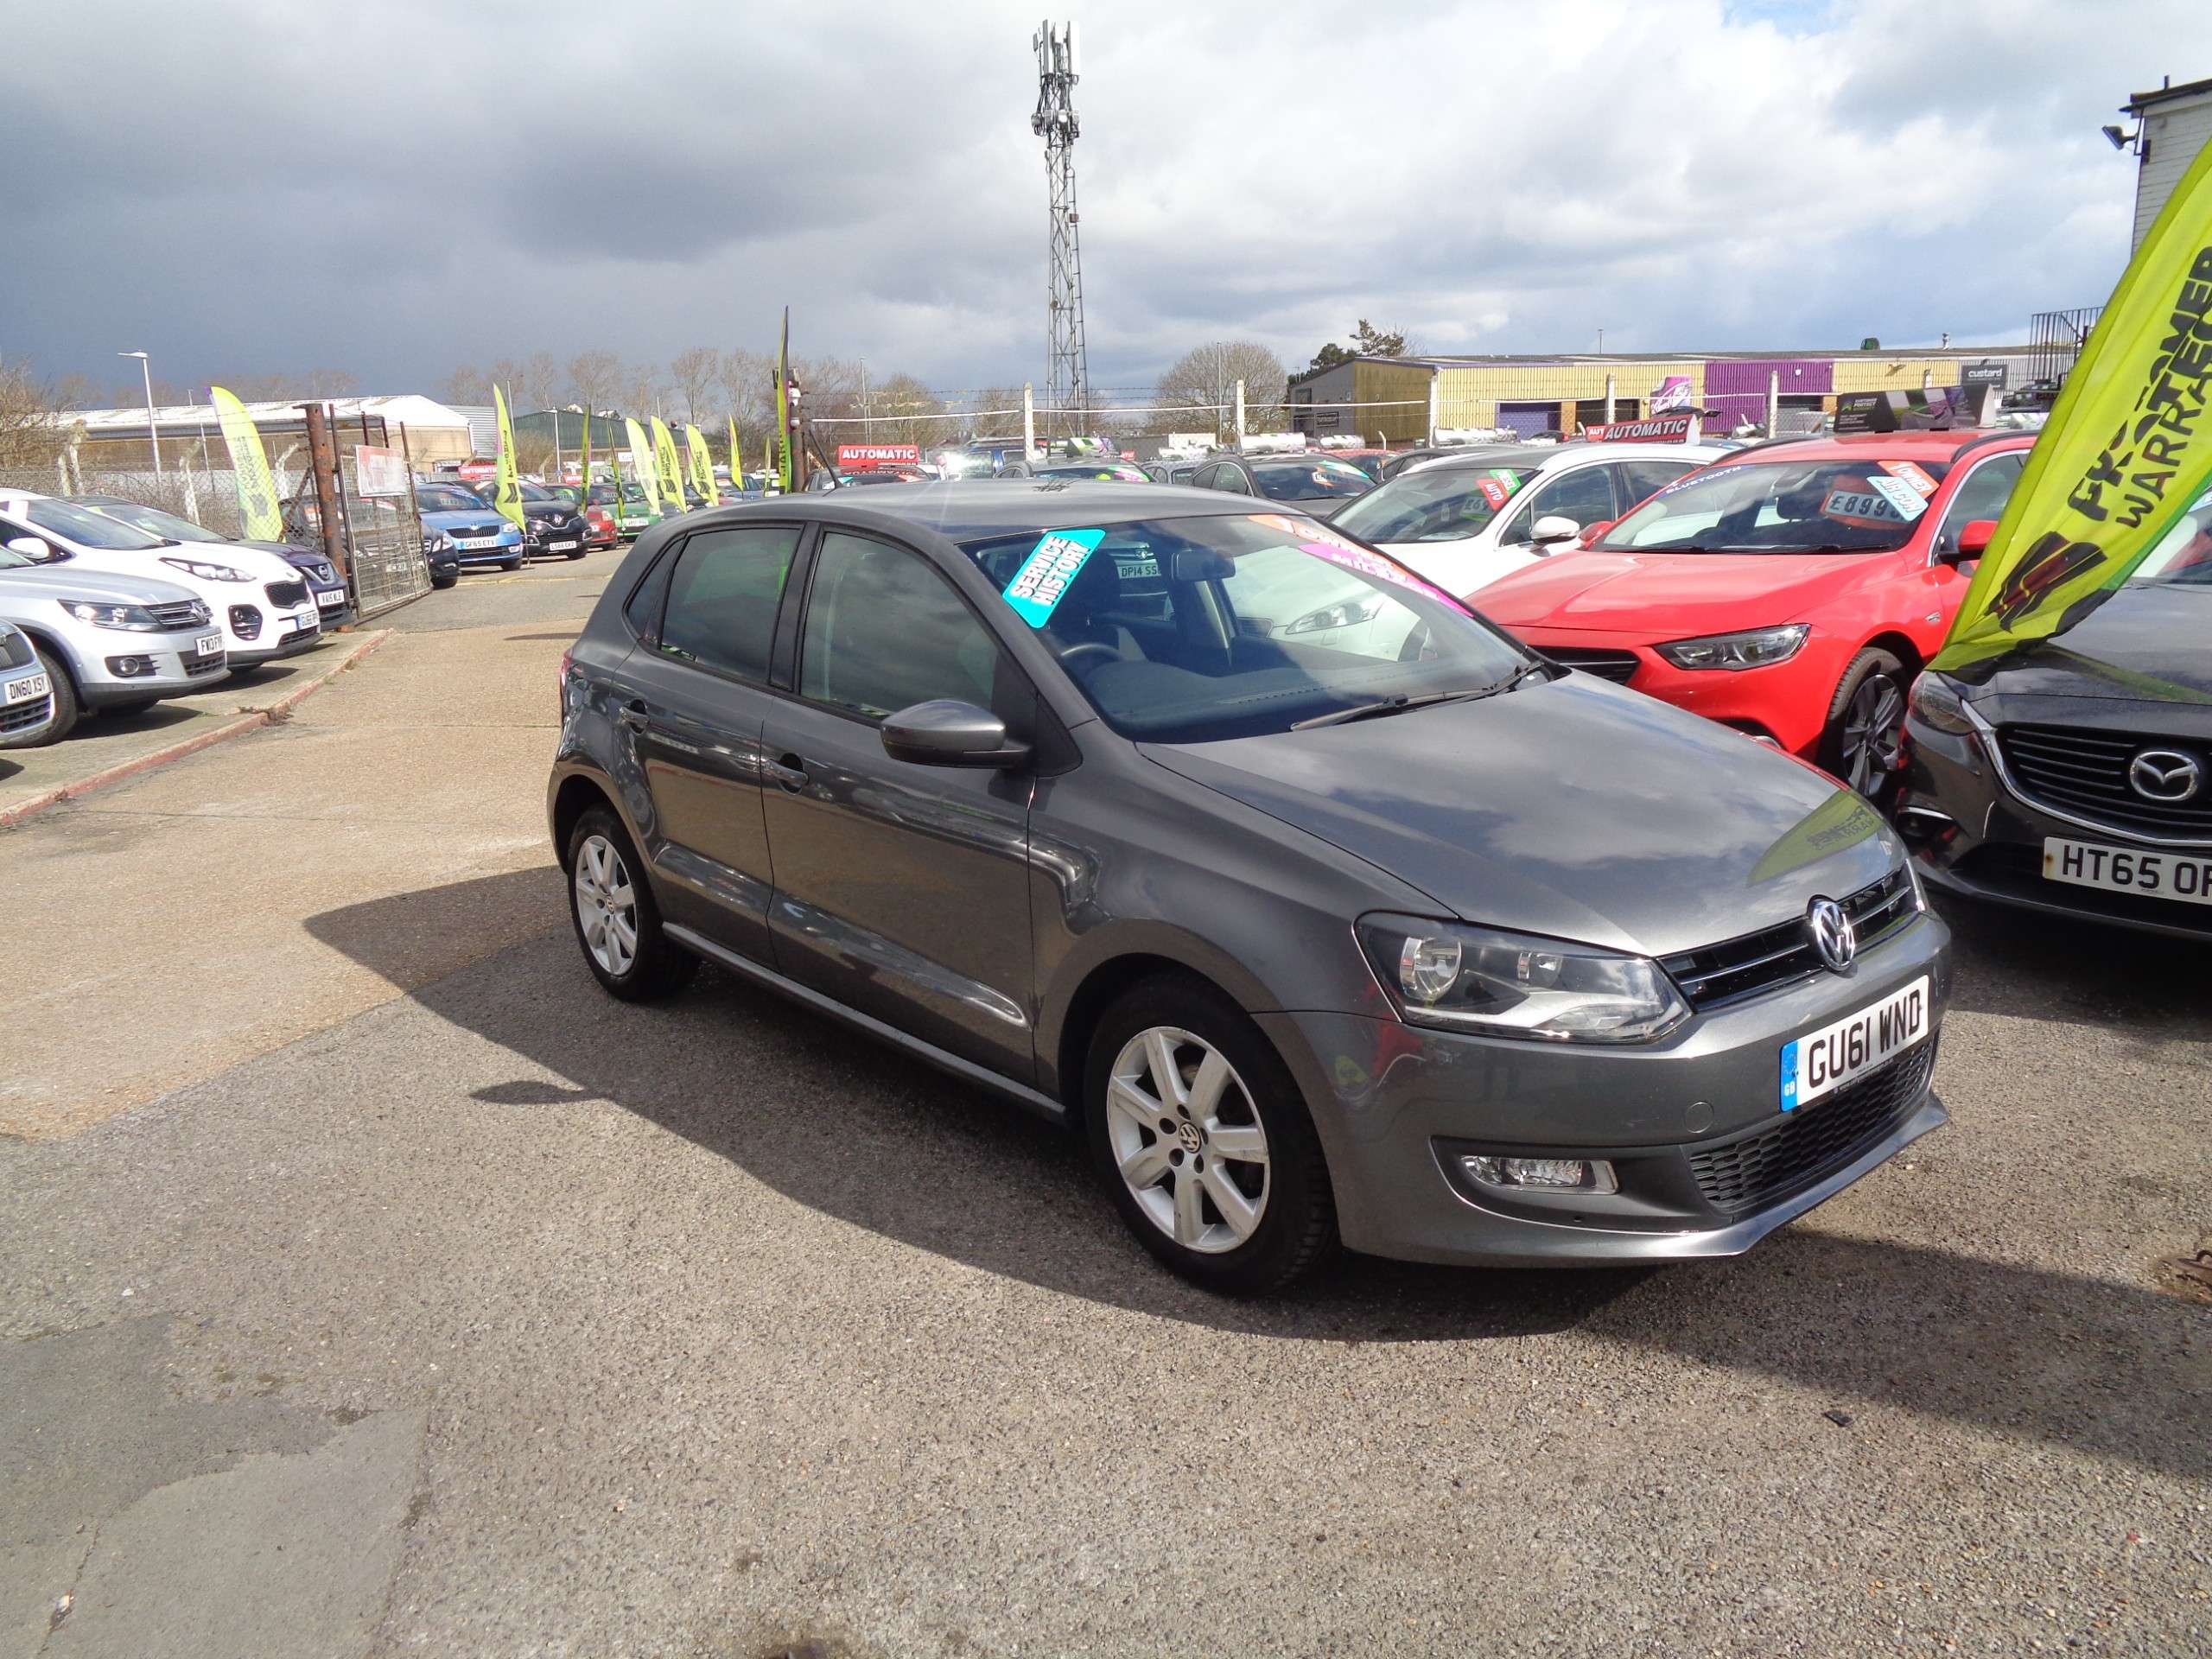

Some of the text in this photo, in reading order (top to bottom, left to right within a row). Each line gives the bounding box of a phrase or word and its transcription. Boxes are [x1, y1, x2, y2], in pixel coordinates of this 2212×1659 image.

[1968, 368, 2003, 378] custard
[1605, 419, 1688, 440] AUTOMATIC
[842, 448, 916, 460] AUTOMATIC
[1666, 465, 1742, 494] BLUETOOTH
[1878, 478, 1900, 496] AIR
[1484, 482, 1503, 501] AUTO
[1009, 536, 1068, 598] SERVICE
[1031, 540, 1092, 606] HISTORY
[1122, 566, 1143, 577] DP14
[10, 679, 32, 699] DN60
[2063, 845, 2161, 889] HT65
[1808, 1017, 1871, 1089] GU61
[1879, 989, 1921, 1054] WND
